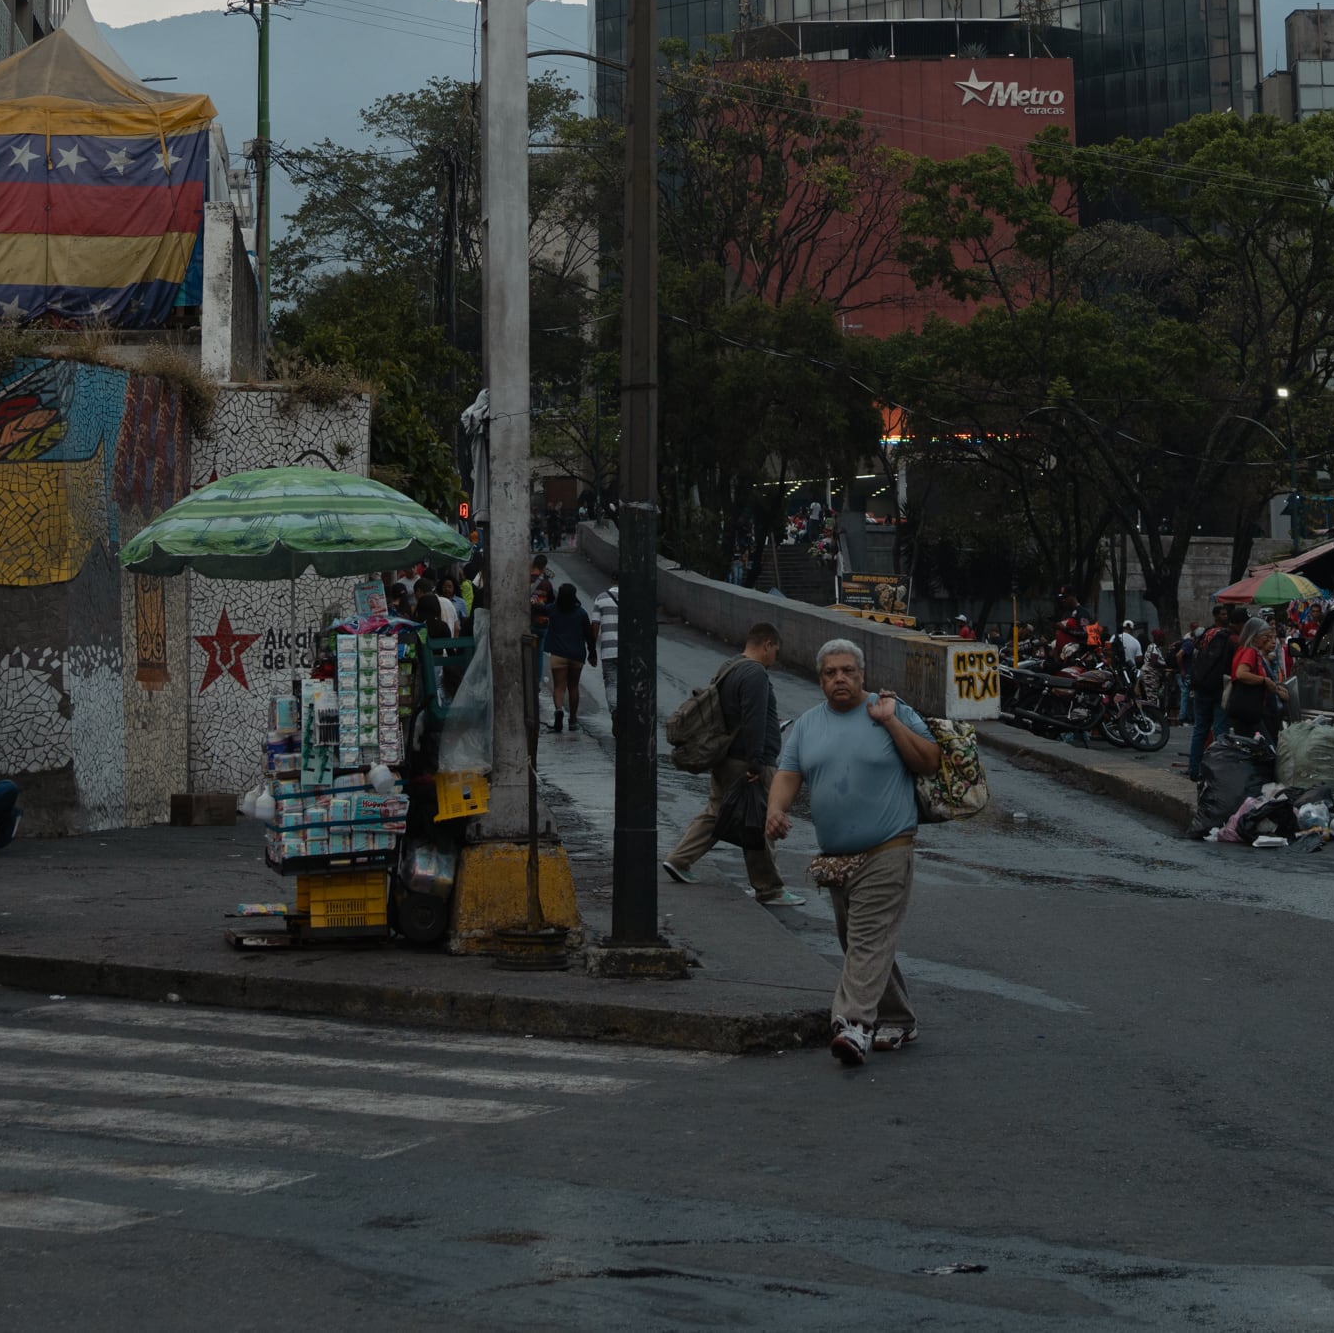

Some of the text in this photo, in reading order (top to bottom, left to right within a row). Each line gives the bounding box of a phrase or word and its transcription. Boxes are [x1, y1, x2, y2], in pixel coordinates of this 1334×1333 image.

[988, 82, 1064, 107] Metro
[1023, 107, 1066, 115] caracas
[262, 649, 285, 670] de
[954, 652, 997, 672] MOTO
[955, 671, 999, 700] TAXI
